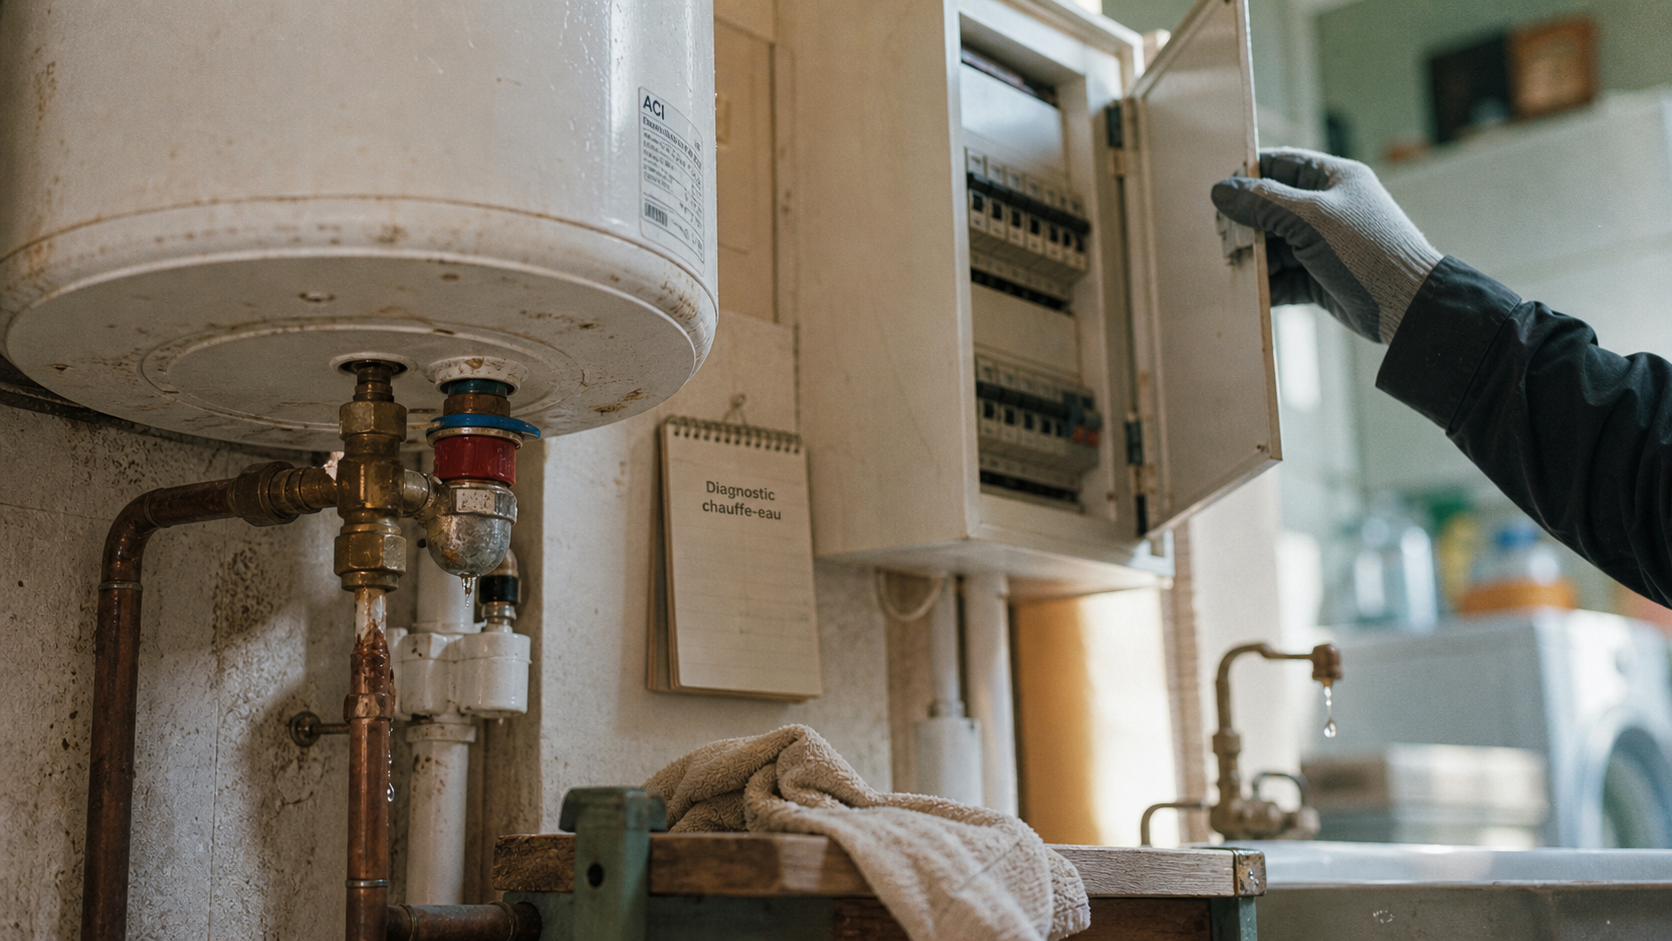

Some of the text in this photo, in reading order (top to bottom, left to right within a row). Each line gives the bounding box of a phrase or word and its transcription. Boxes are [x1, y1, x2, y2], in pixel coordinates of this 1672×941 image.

[643, 95, 665, 120] ACI
[706, 480, 775, 501] Diagnostic
[702, 499, 781, 520] chauffe-eau
